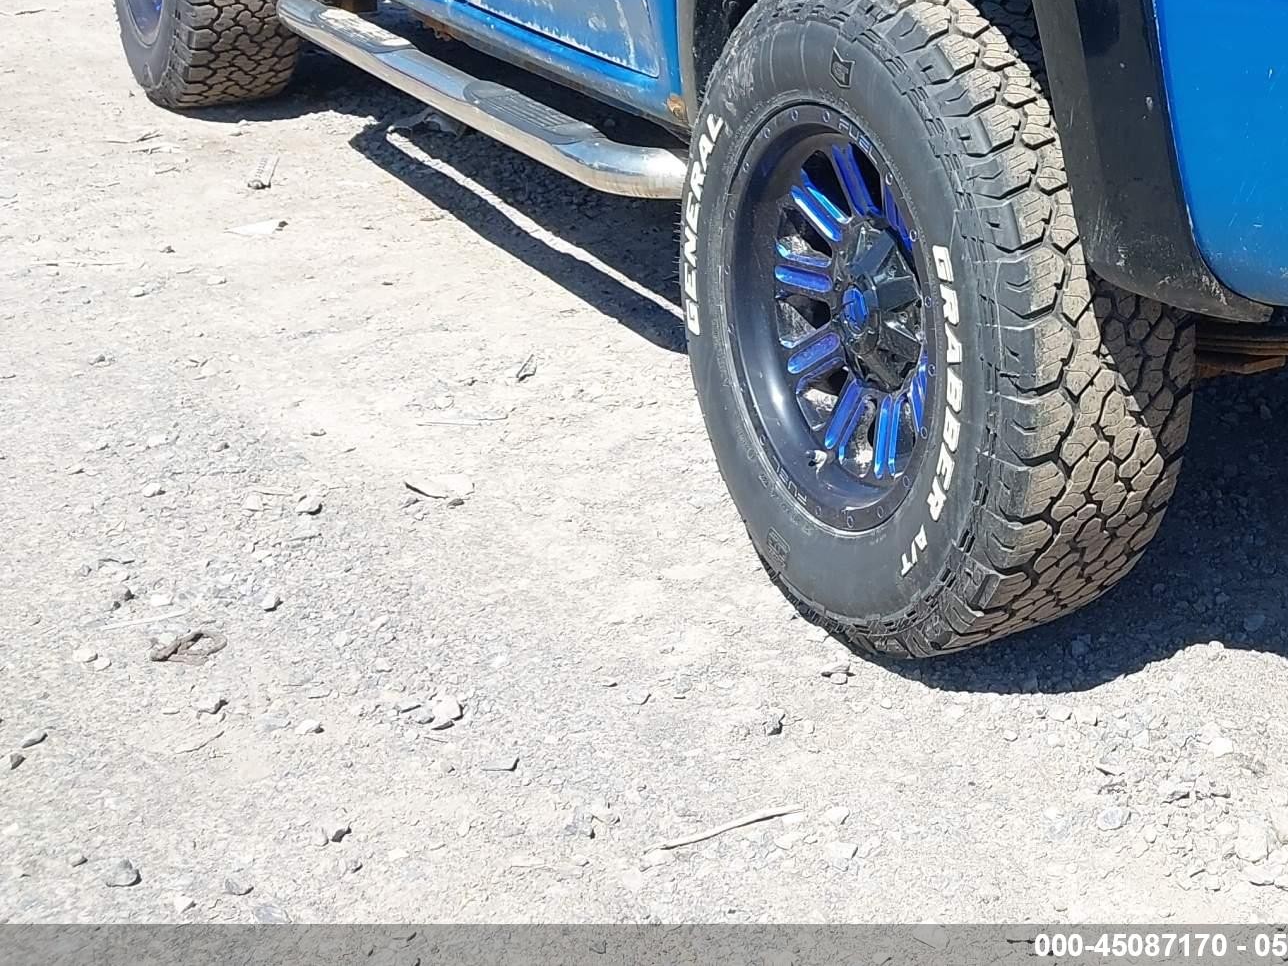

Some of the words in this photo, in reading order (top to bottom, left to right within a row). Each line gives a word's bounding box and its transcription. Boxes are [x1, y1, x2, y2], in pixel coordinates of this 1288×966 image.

[838, 118, 878, 165] FUEL
[684, 113, 724, 336] GENERAL
[927, 245, 963, 522] GRABBER
[773, 455, 808, 506] FUEL
[901, 524, 928, 577] A/T
